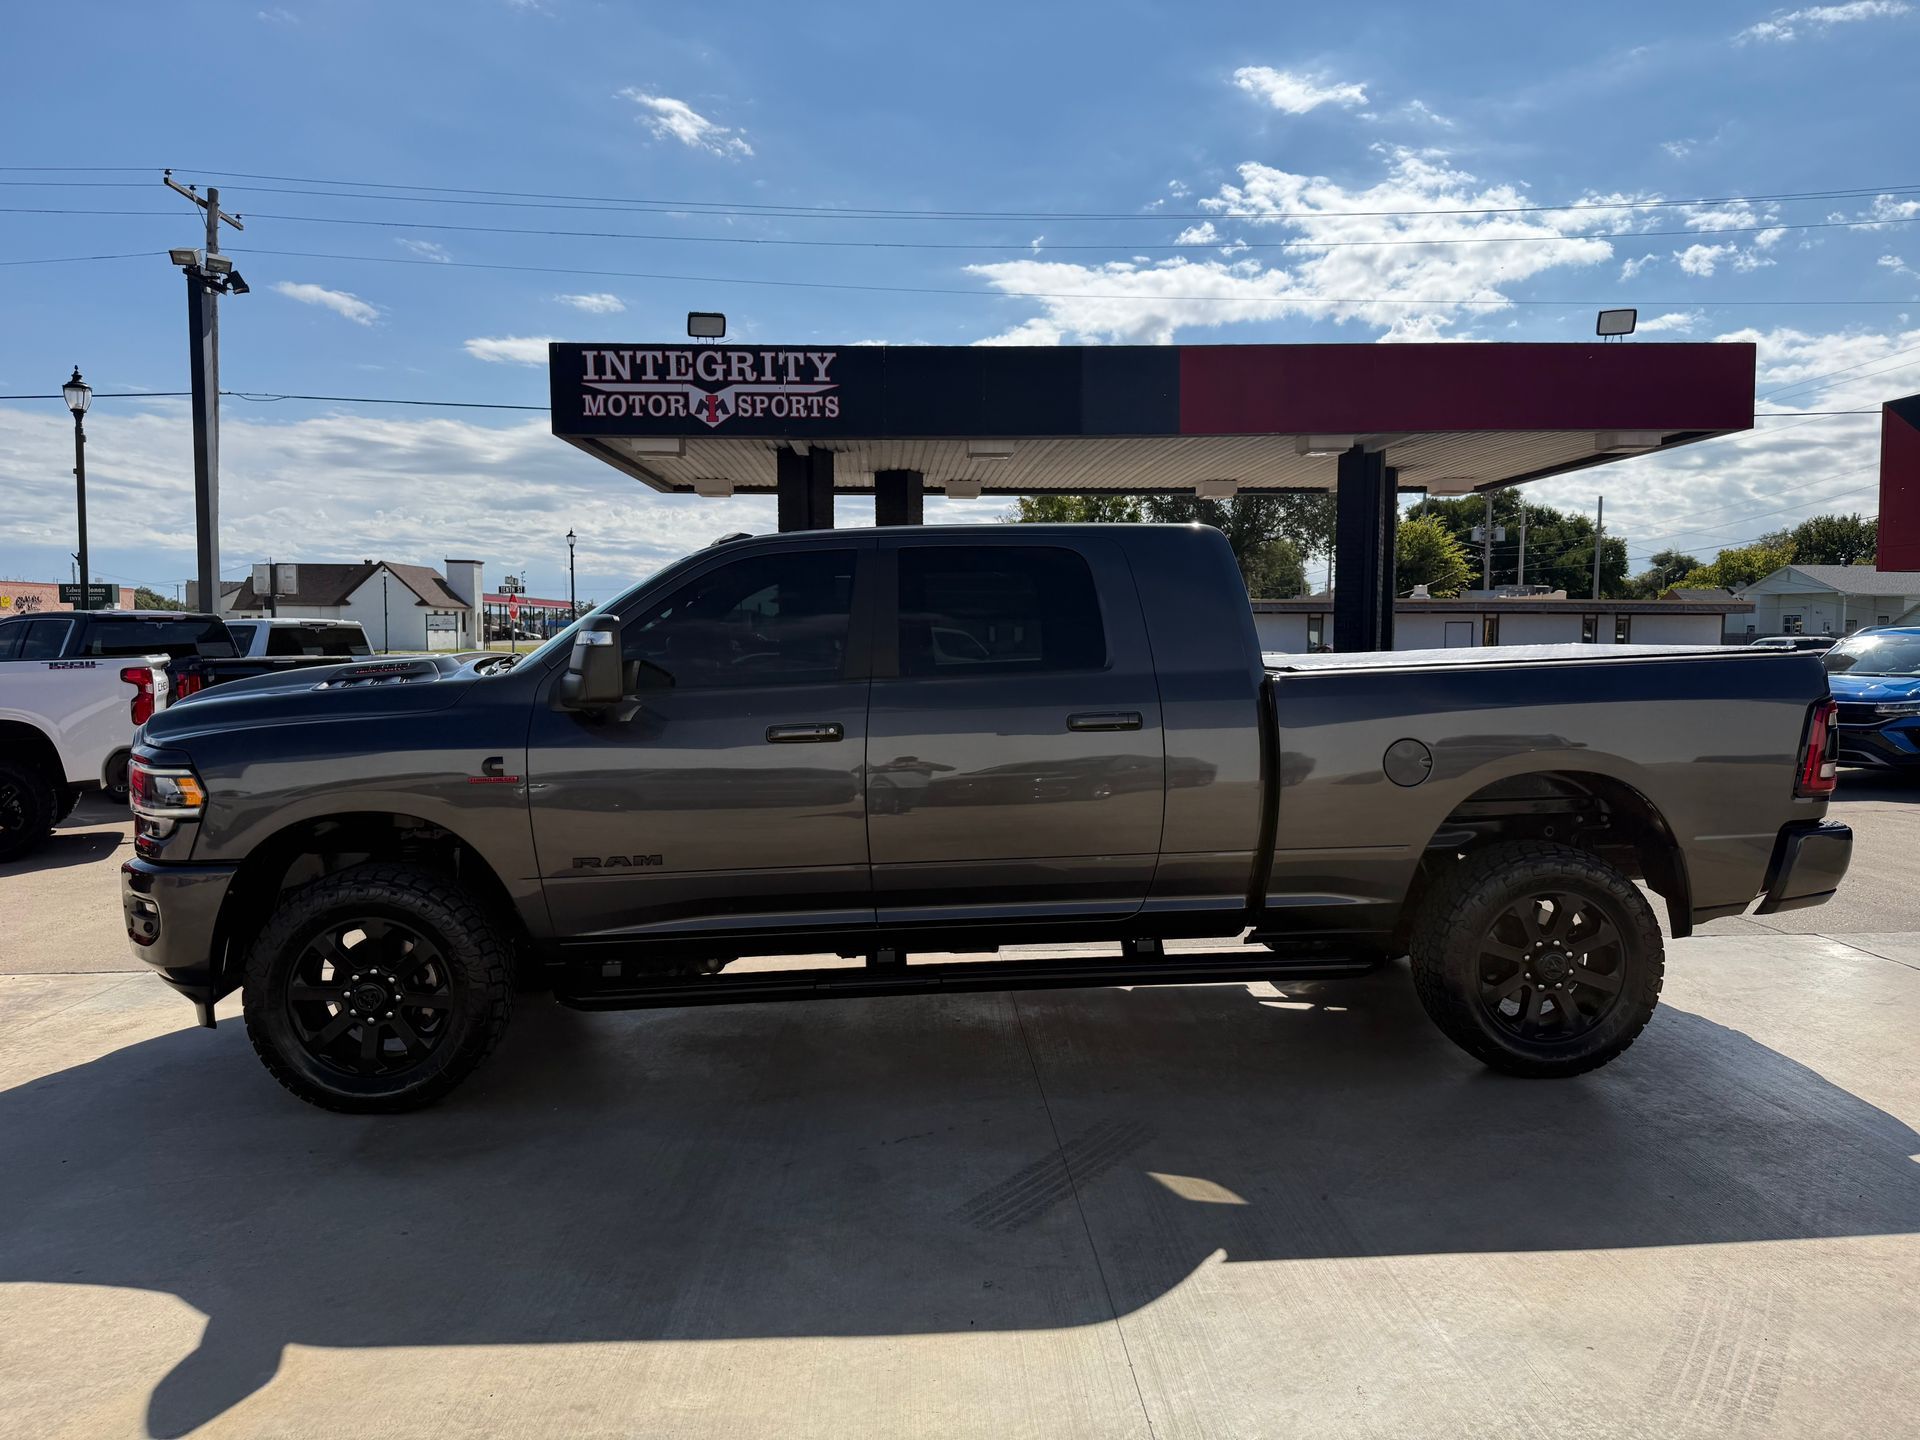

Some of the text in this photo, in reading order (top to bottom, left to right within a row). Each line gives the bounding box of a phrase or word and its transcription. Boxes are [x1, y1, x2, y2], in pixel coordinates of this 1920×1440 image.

[581, 350, 837, 382] INTEGRITY
[582, 394, 840, 418] MOTOR SPORTS
[573, 854, 663, 869] RAM
